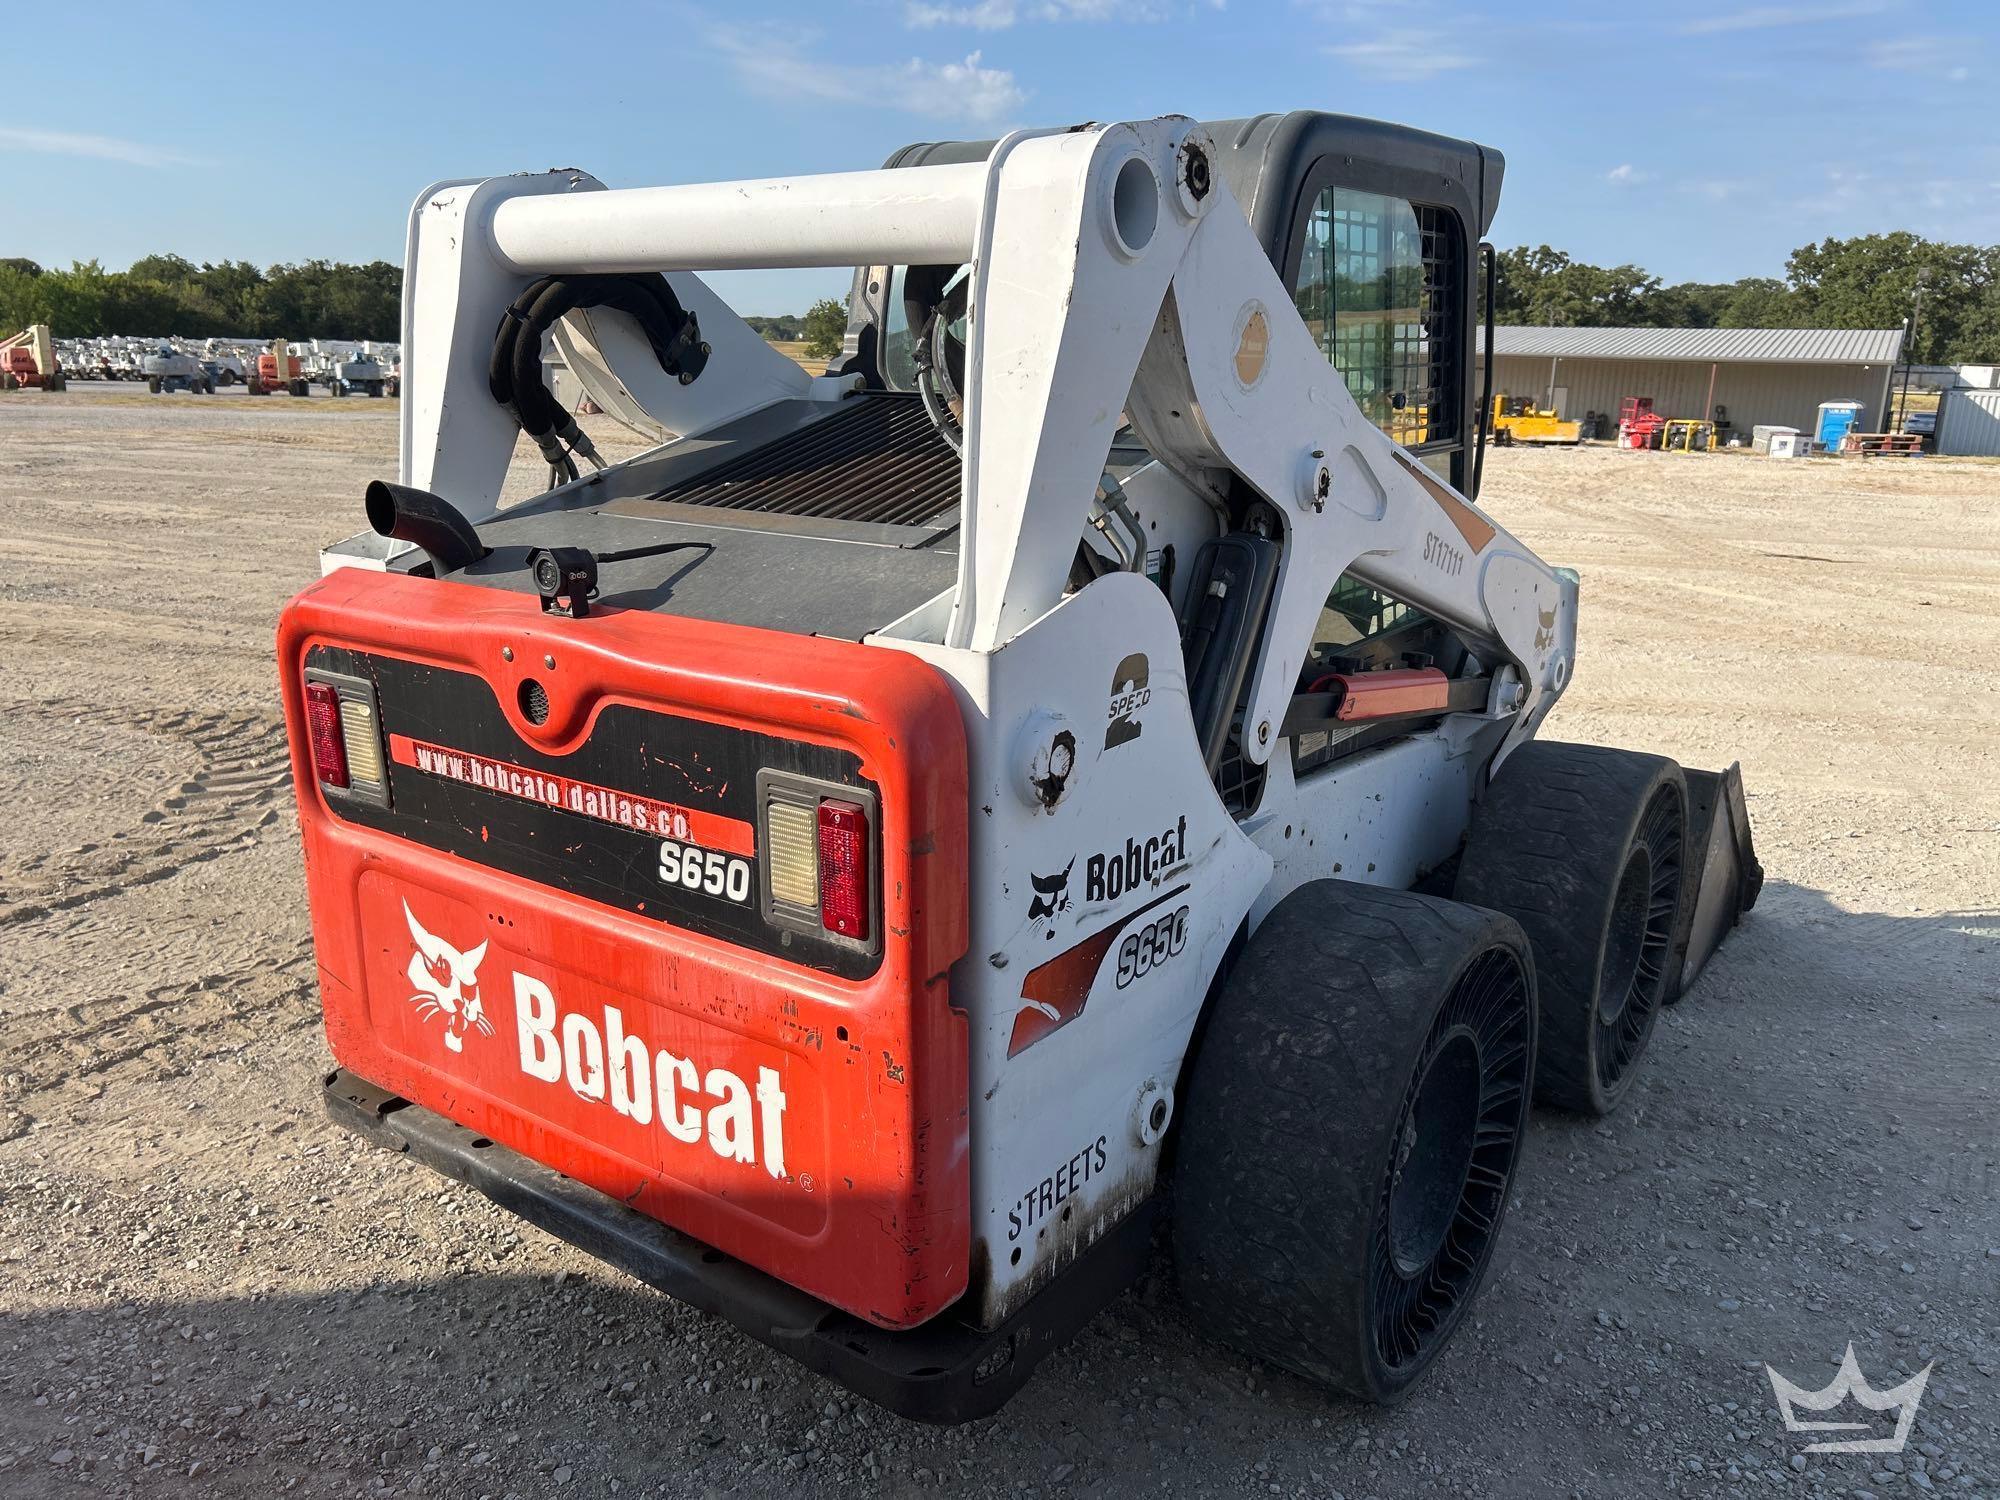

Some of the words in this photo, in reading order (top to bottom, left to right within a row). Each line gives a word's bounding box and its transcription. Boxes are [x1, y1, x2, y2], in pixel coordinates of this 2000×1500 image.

[1423, 531, 1464, 576] ST17111
[659, 841, 750, 902] S650
[1086, 816, 1187, 902] Bobcat
[1116, 904, 1190, 990] S650
[512, 970, 788, 1180] Bobcat
[1007, 1134, 1107, 1242] STREETS
